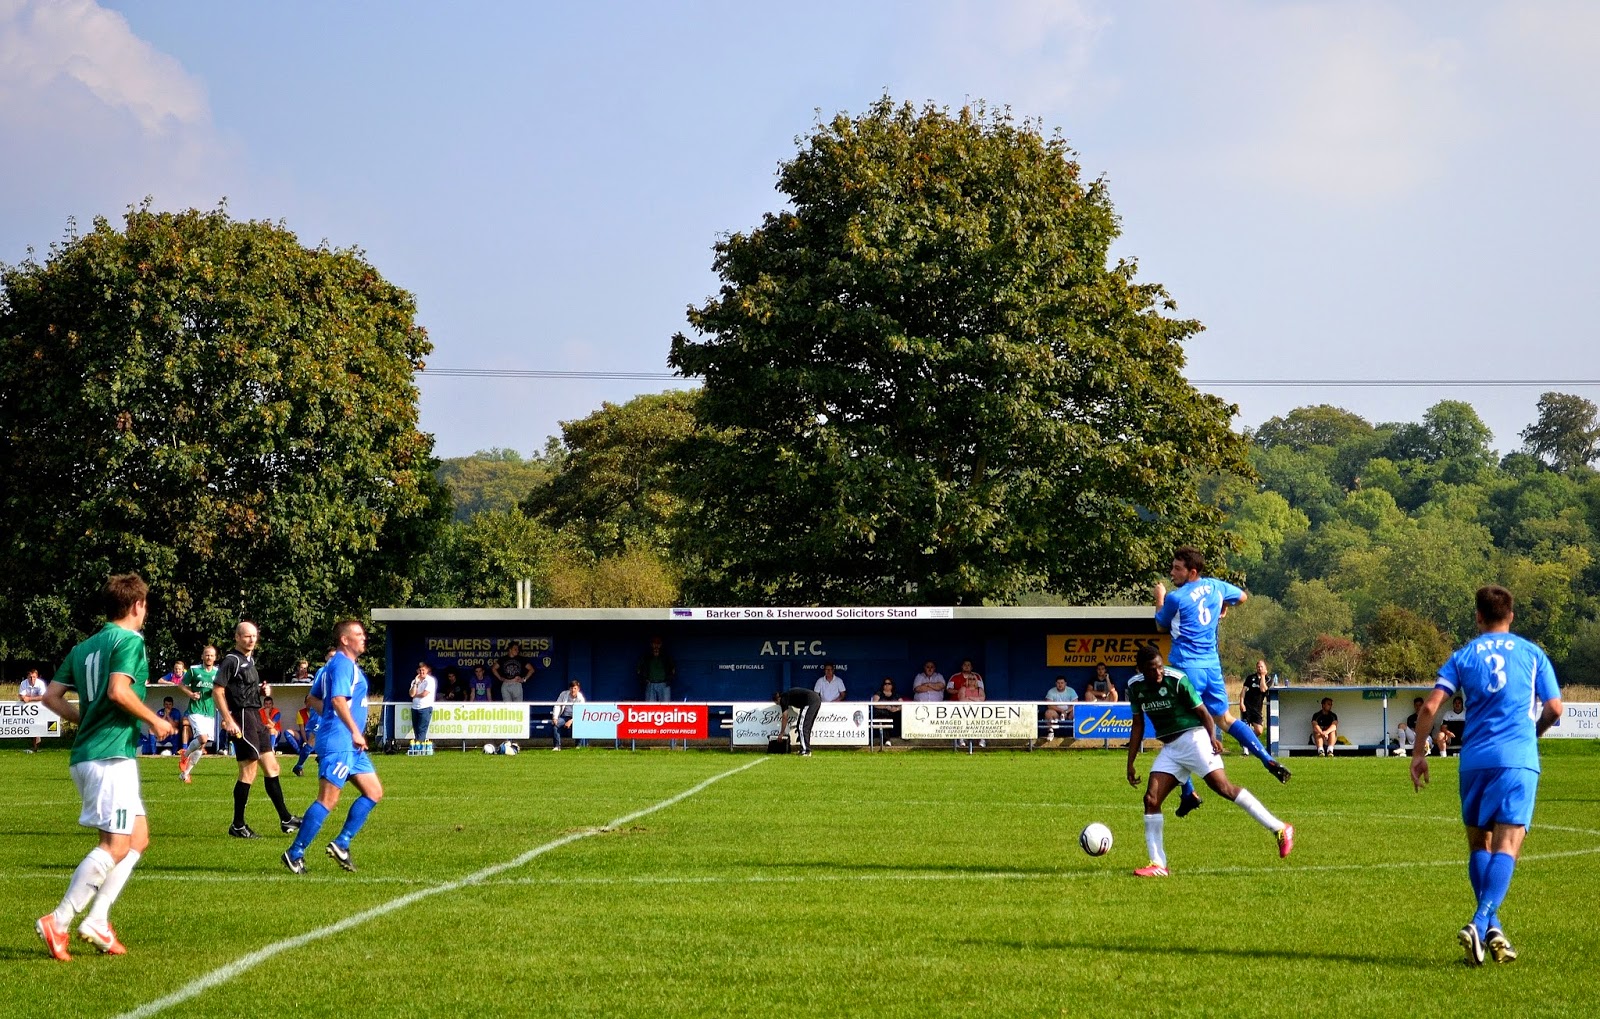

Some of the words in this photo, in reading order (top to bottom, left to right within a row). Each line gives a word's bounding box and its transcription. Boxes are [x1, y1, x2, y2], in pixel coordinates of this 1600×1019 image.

[1190, 585, 1211, 602] ATFC
[706, 609, 740, 618] Barker
[744, 609, 763, 618] Son
[766, 609, 774, 618] &
[777, 609, 833, 618] Isherwood
[836, 608, 885, 618] Solicitors
[886, 608, 917, 618] Stand
[1198, 598, 1211, 626] 6
[428, 639, 491, 650] PALMERS
[1064, 638, 1160, 653] EXPRESS
[1476, 640, 1515, 654] ATFC
[1064, 654, 1097, 663] MOTOR
[1103, 654, 1138, 663] WORKS
[84, 650, 101, 702] 11
[1485, 653, 1507, 693] 3
[453, 707, 523, 722] Scaffolding
[581, 709, 621, 722] home
[627, 708, 697, 726] bargains
[814, 712, 848, 723] ractice
[936, 706, 1021, 719] BAWDEN
[1567, 707, 1598, 718] David
[2, 717, 35, 725] HEATING
[1078, 709, 1133, 735] Johnso
[332, 761, 349, 780] 10
[115, 809, 127, 830] 11
